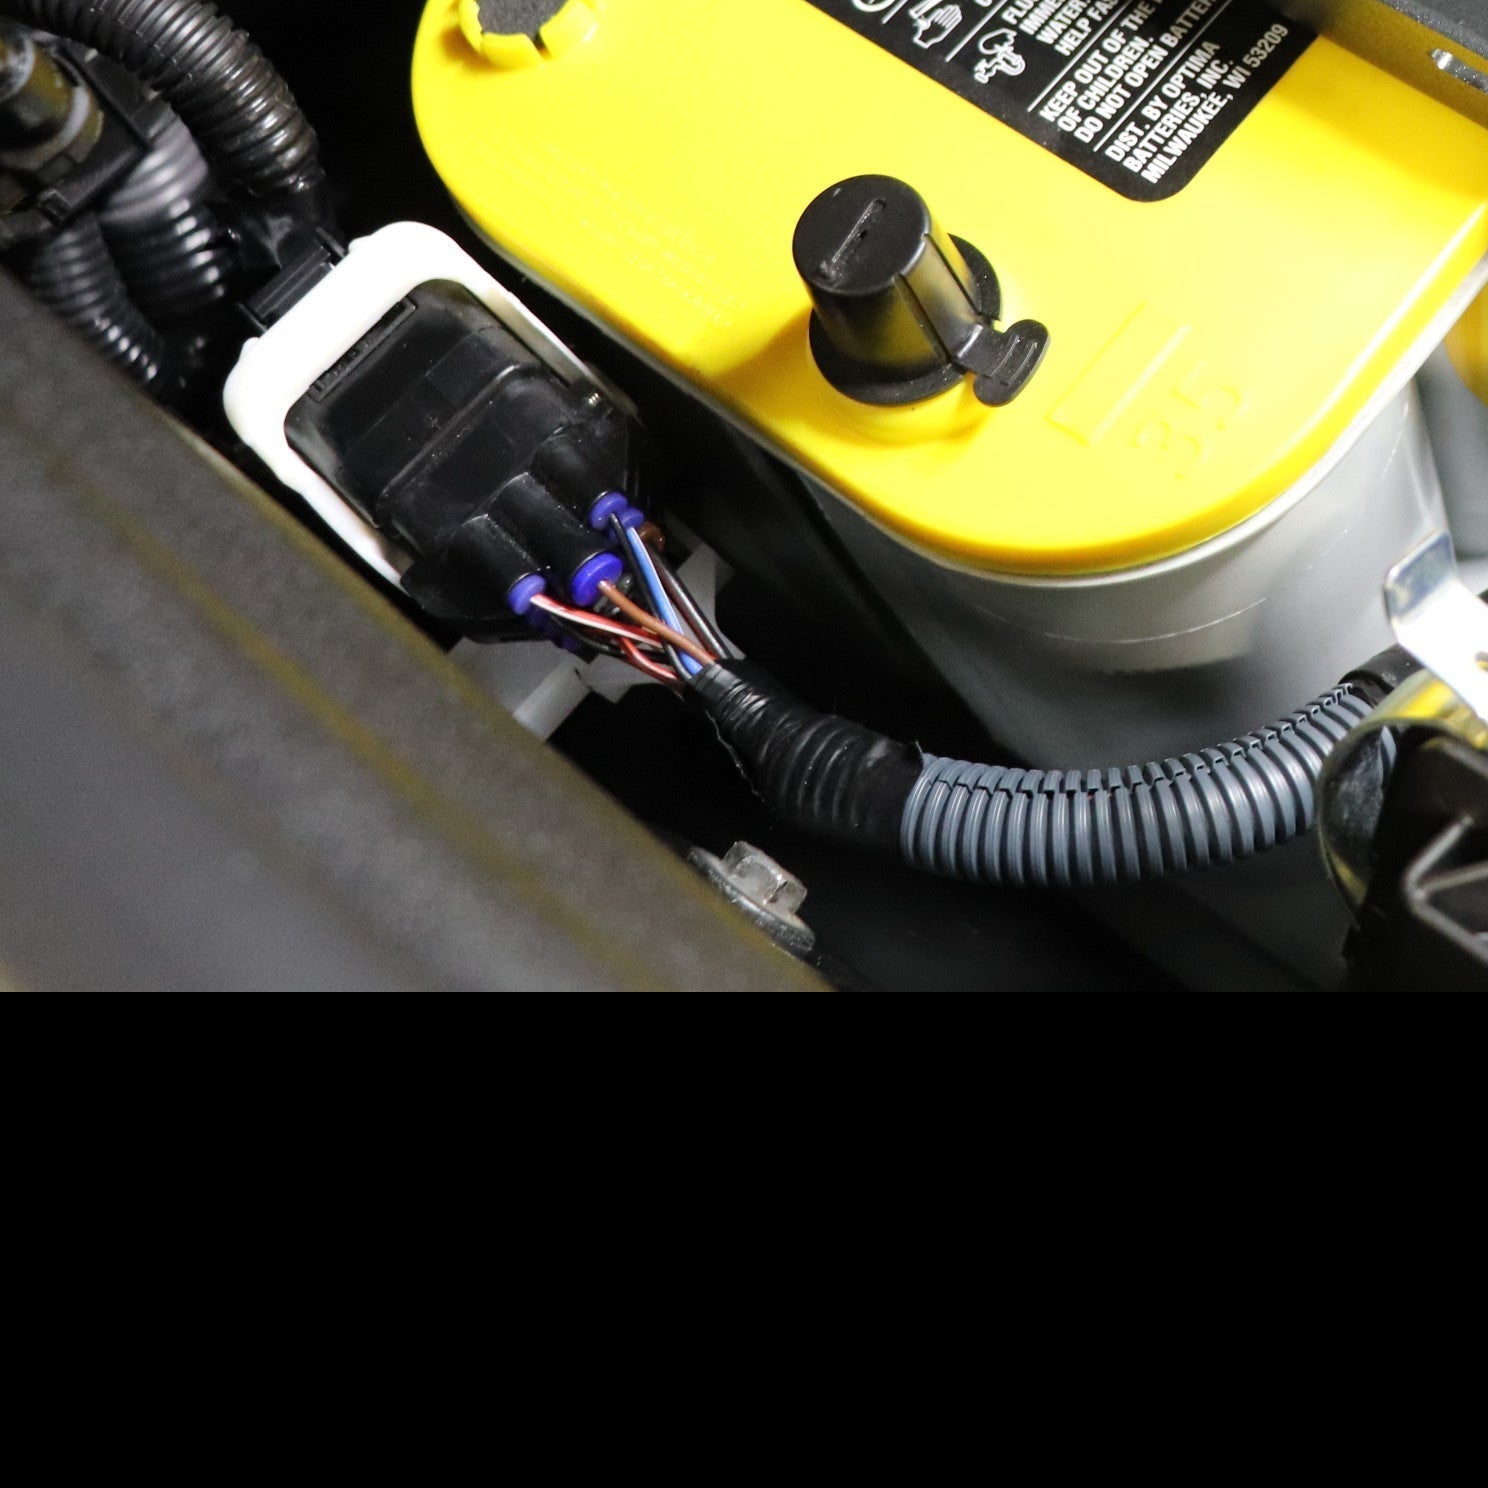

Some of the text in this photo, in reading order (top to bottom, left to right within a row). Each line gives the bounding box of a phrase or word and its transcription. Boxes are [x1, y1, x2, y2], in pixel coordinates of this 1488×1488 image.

[1039, 81, 1079, 123] KEEP
[1073, 49, 1109, 85] OUT
[1102, 27, 1128, 54] OF
[1054, 17, 1092, 56] HELP
[1056, 36, 1154, 133] OF CHILDREN.
[1074, 115, 1104, 144] DO
[1095, 84, 1131, 120] NOT
[1123, 43, 1169, 88] OPEN
[1104, 40, 1221, 163] DIST. BY OPTIMA
[1122, 58, 1234, 174] BATTERIES, INC.
[1140, 23, 1289, 184] MILWAUKEE, WI 53209
